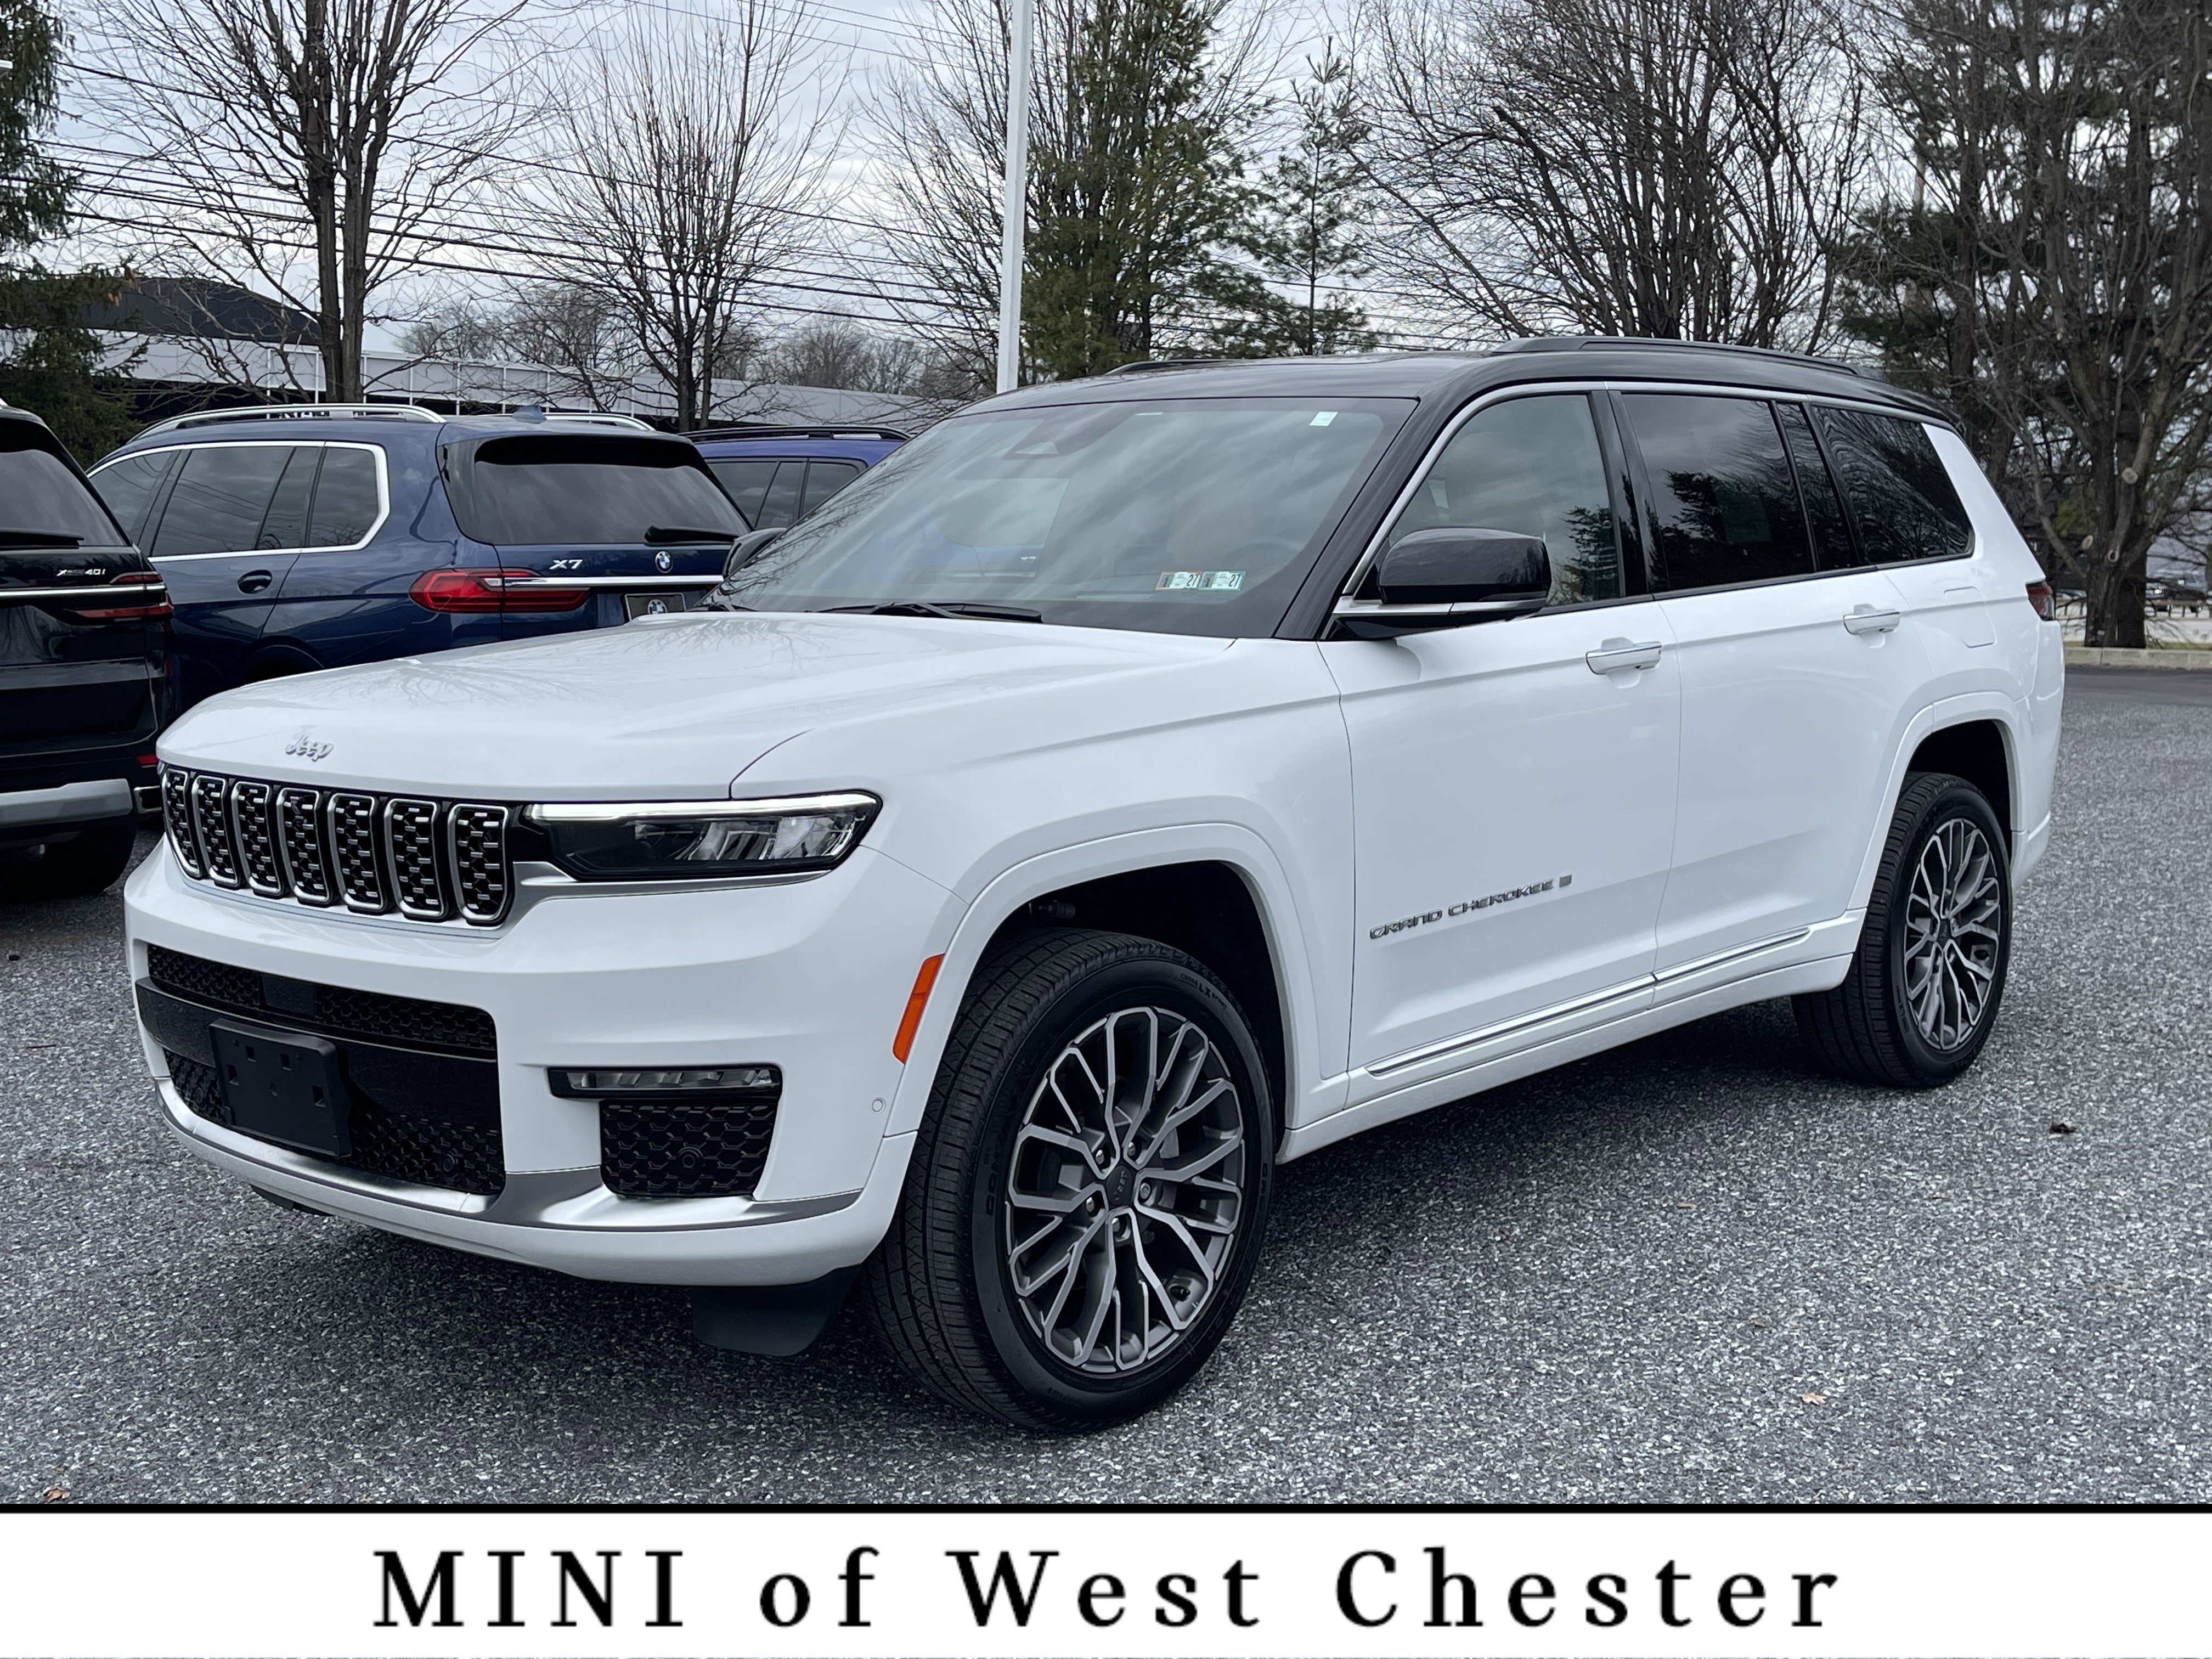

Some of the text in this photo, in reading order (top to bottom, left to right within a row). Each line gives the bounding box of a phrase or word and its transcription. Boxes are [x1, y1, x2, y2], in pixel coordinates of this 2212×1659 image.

[549, 558, 583, 570] X7
[1186, 573, 1199, 587] 27
[1228, 573, 1241, 588] 27
[285, 735, 334, 762] Jeep
[1369, 878, 1554, 939] GRAND CHEROKEE
